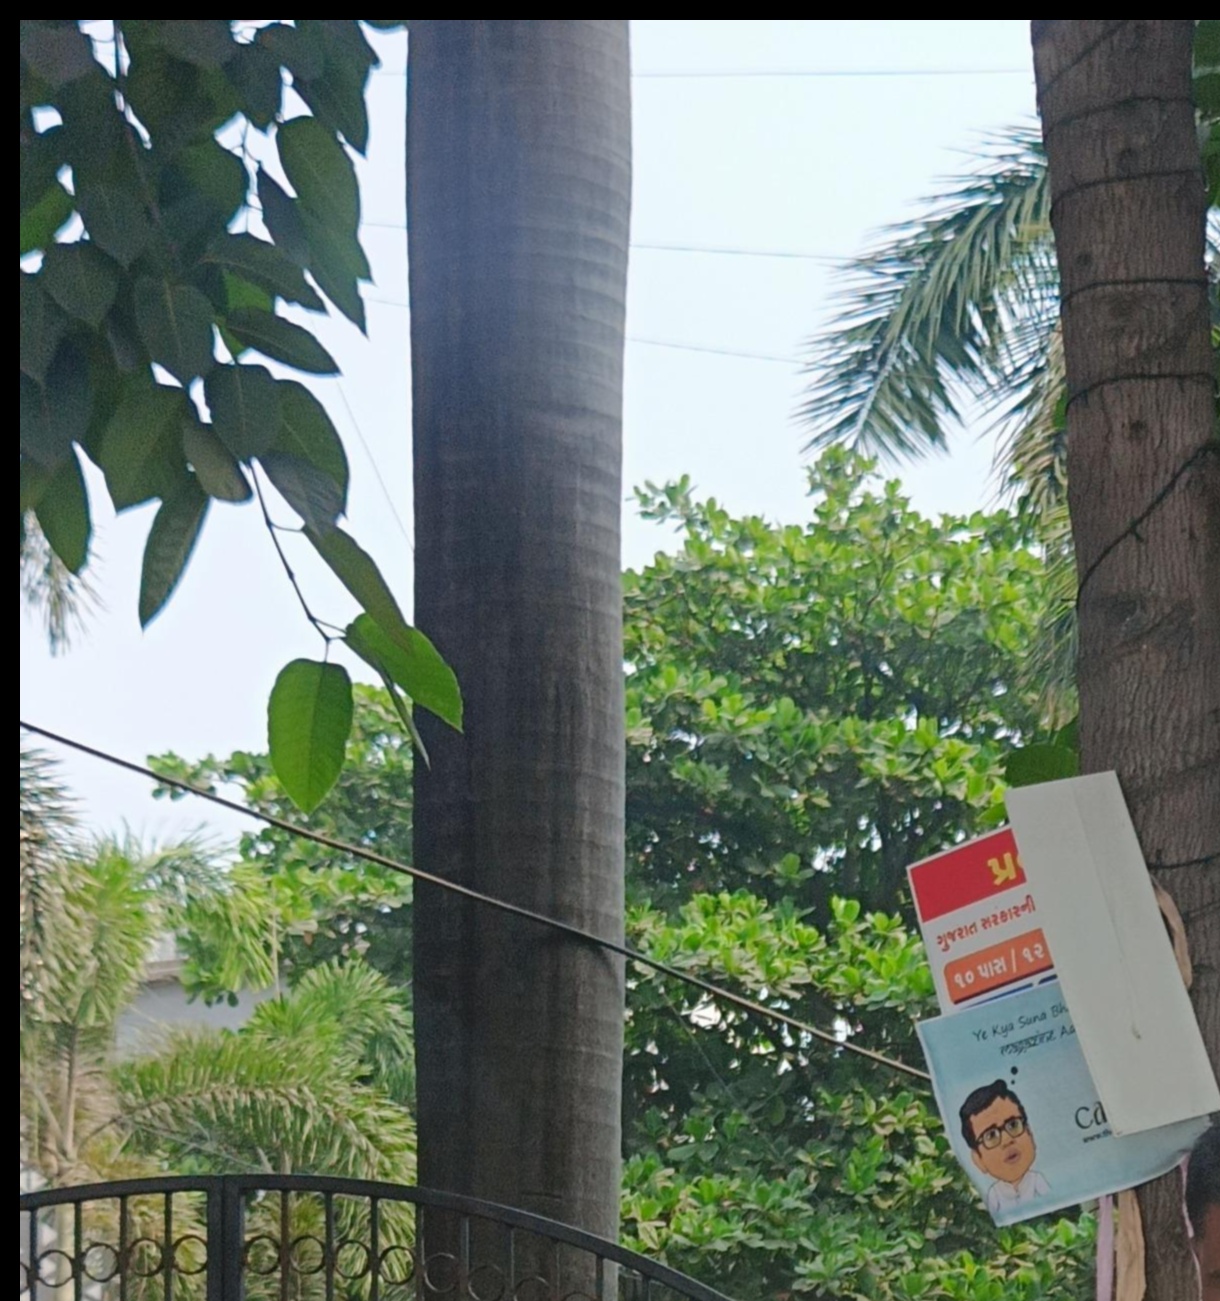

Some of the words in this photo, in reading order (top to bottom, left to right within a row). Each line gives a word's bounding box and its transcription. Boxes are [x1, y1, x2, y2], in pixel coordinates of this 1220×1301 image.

[987, 852, 1024, 886] પ્ર
[936, 922, 978, 952] ગુજરાત
[980, 894, 1036, 930] સરકારની
[954, 970, 975, 988] ૧૦
[977, 956, 1006, 979] પાસ
[1022, 943, 1044, 963] ૧૨
[972, 1028, 988, 1042] Ye
[992, 1022, 1015, 1039] Kya
[1018, 1012, 1047, 1030] Suna
